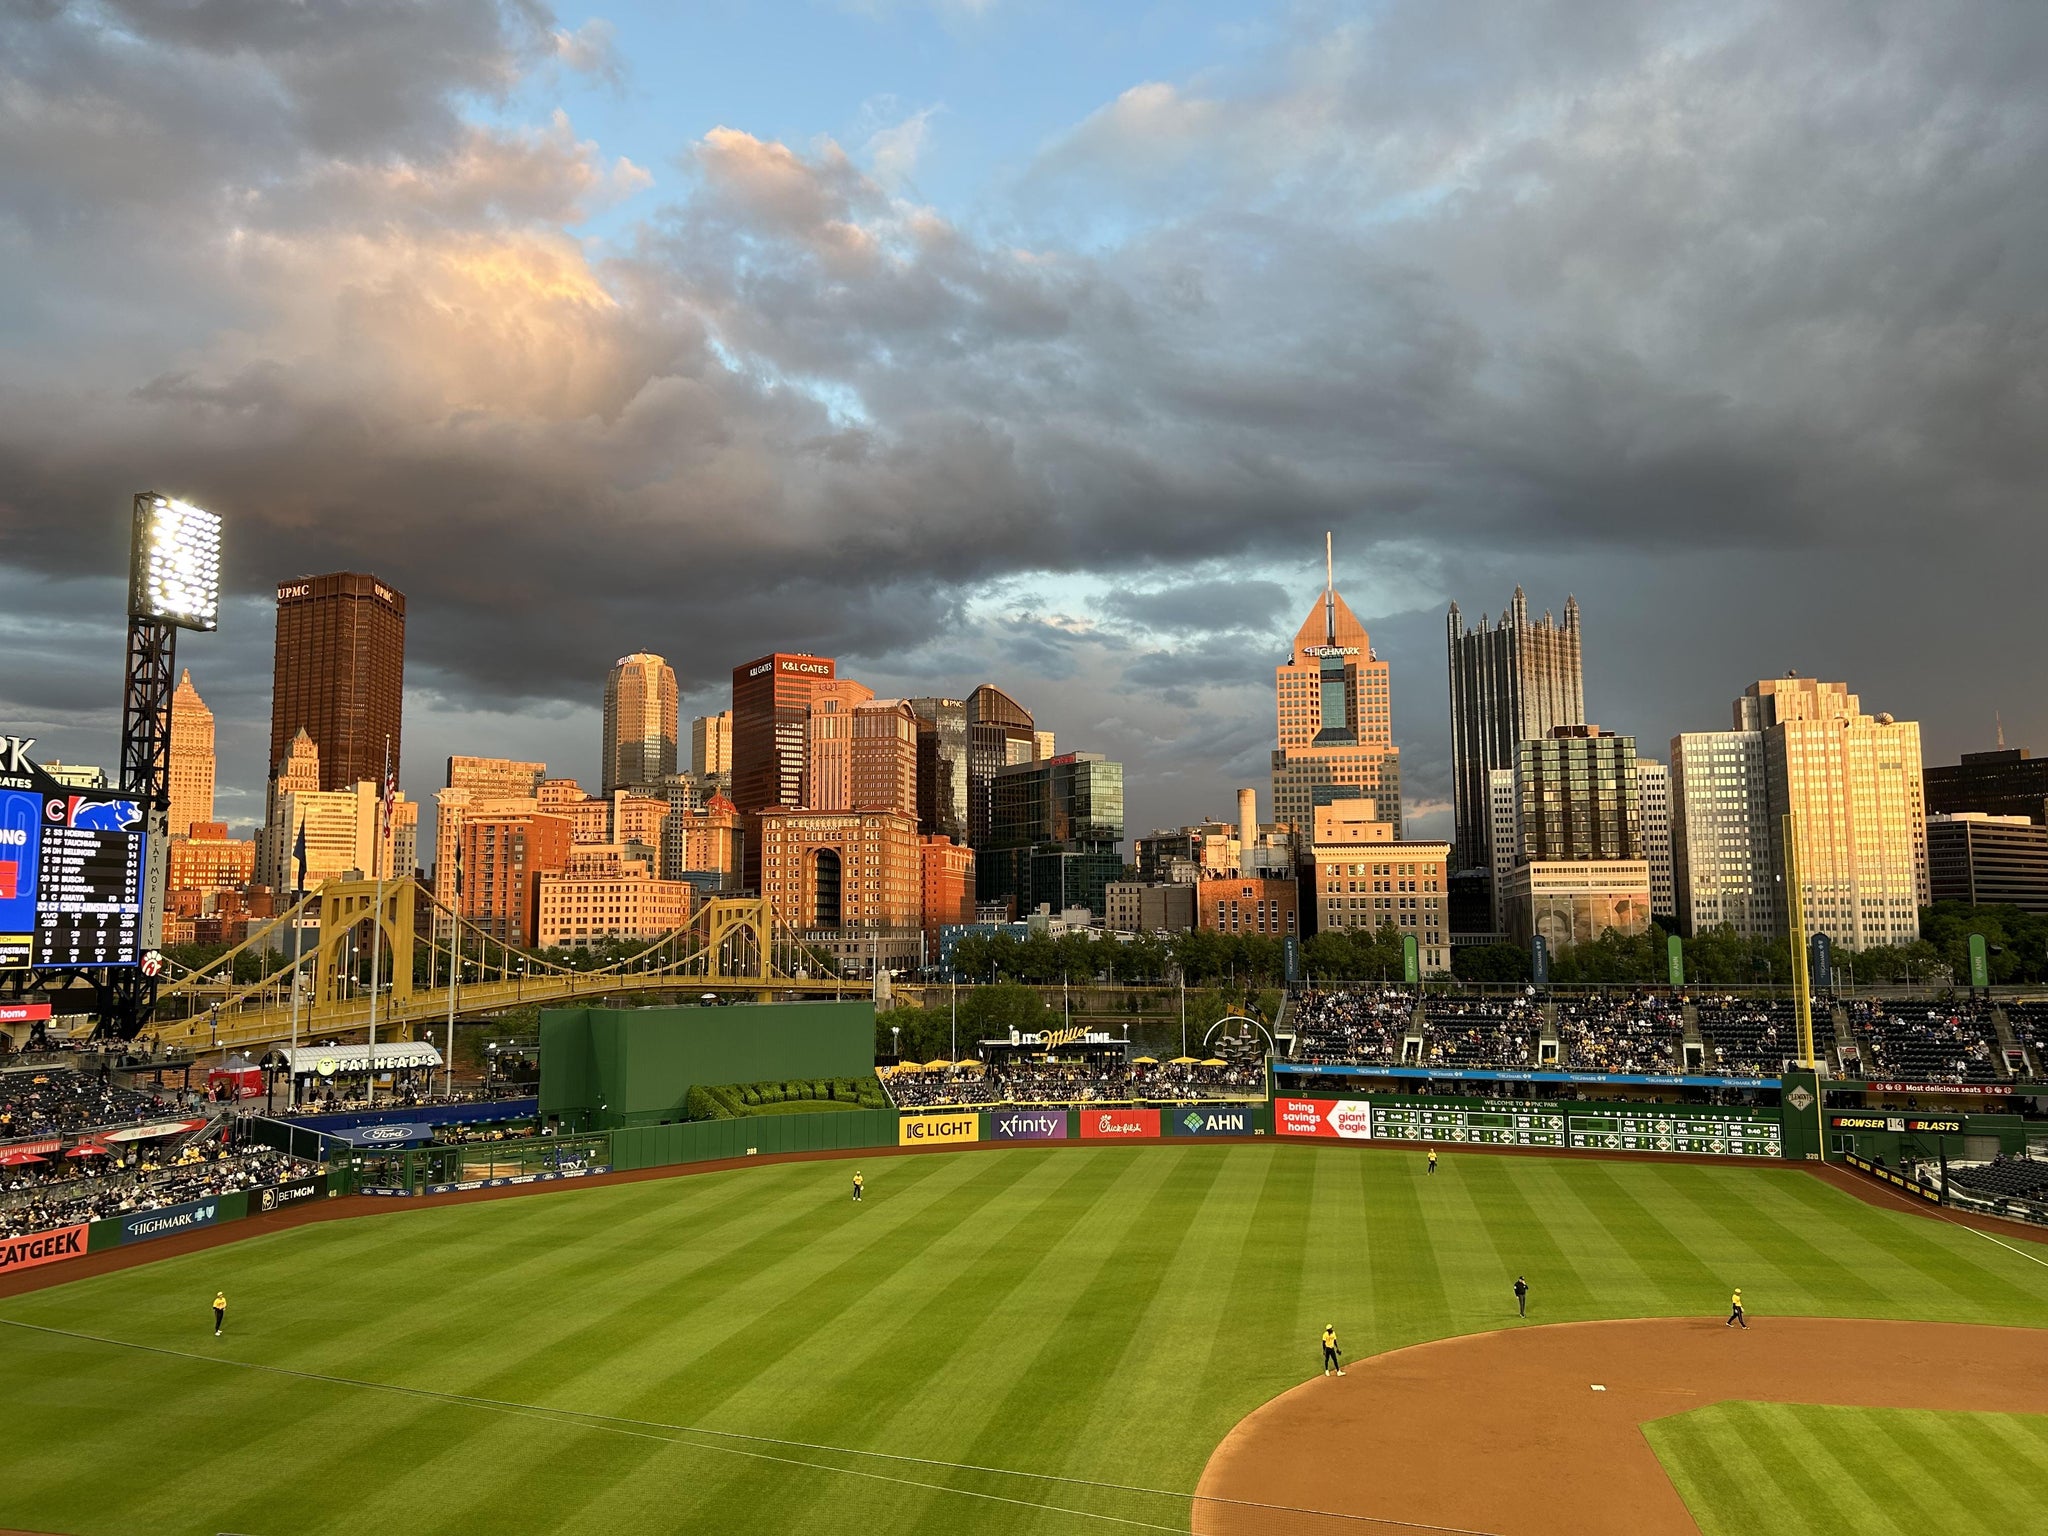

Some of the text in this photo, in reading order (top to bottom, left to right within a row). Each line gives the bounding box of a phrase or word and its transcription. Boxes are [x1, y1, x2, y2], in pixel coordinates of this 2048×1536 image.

[278, 585, 310, 599] UPMC
[374, 584, 393, 603] UPMC
[1309, 647, 1360, 656] HIGHMARK
[750, 662, 772, 676] K&L GATES
[782, 662, 829, 674] K&L GATES
[45, 828, 51, 836] 2
[150, 867, 160, 892] MOR
[37, 902, 47, 911] 52
[48, 903, 59, 911] CF
[147, 896, 156, 946] CHIKIN
[0, 1010, 27, 1018] home
[1022, 1034, 1041, 1044] IT'S
[1039, 1026, 1093, 1051] Miller
[340, 1054, 436, 1072] FAT HEAD'S
[1288, 1102, 1315, 1114] bring
[1206, 1115, 1244, 1130] AHN
[1283, 1112, 1321, 1124] savings
[1338, 1112, 1366, 1122] giant
[906, 1122, 972, 1138] IC LIGHT
[1000, 1115, 1058, 1136] xfinity
[1288, 1122, 1316, 1132] home
[1338, 1122, 1367, 1133] eagle
[1840, 1118, 1959, 1131] BOWSER BLASTS
[372, 1129, 404, 1138] Ford
[279, 1186, 314, 1201] BETMGM
[134, 1212, 192, 1236] HIGHMARK
